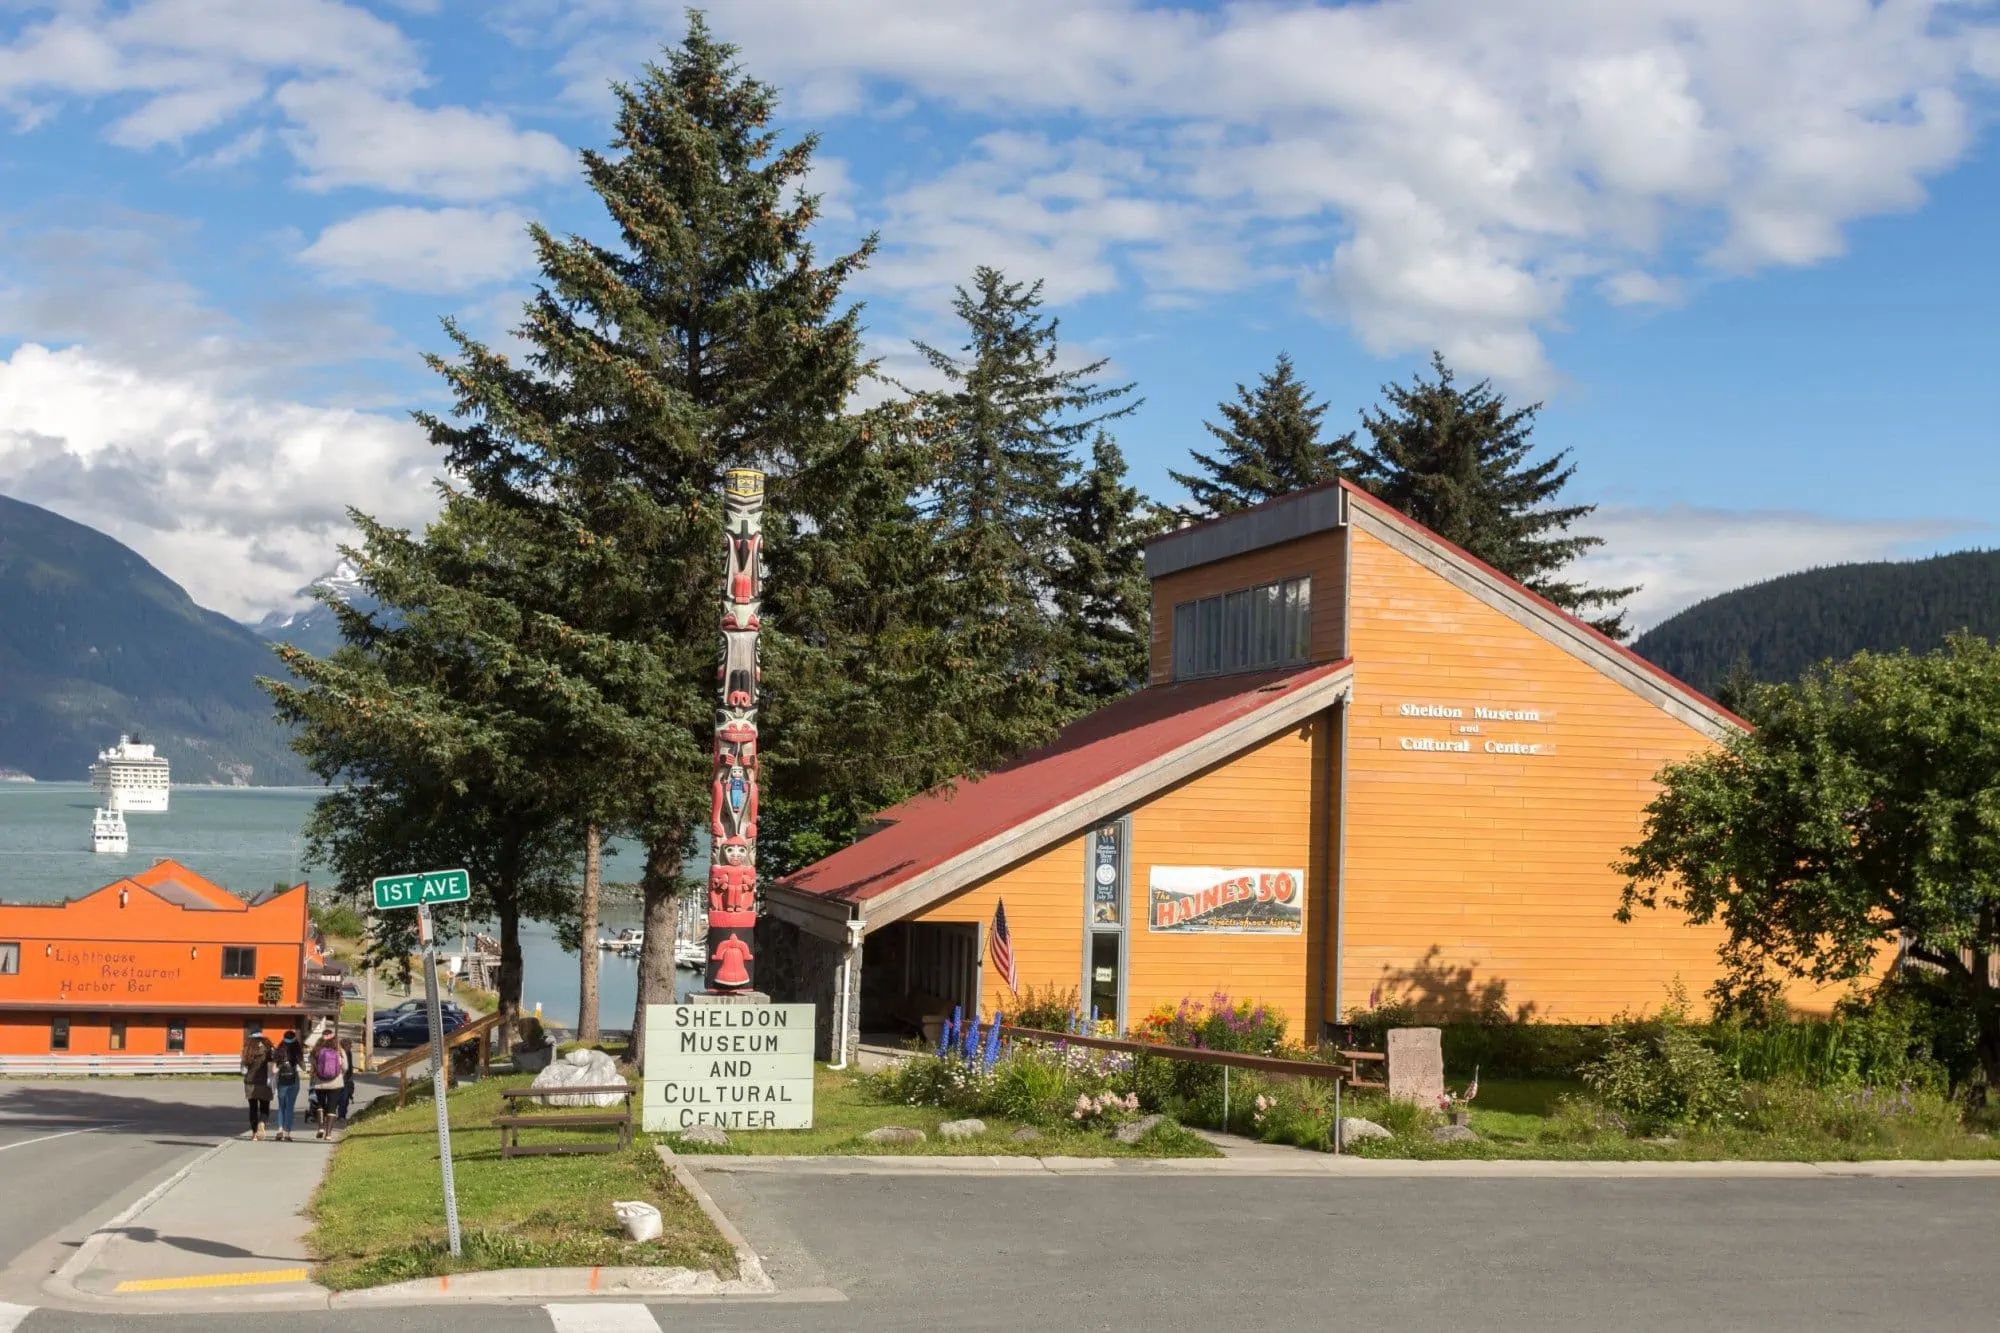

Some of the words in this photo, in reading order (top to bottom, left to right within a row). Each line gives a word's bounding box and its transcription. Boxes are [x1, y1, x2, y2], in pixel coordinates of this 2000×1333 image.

[1400, 703, 1462, 718] Sheldon
[1474, 706, 1539, 721] Museum
[1459, 725, 1479, 733] and
[1400, 736, 1470, 752] Cultural
[1484, 741, 1539, 755] Center
[382, 882, 414, 902] 1ST
[422, 877, 461, 898] AVE
[1154, 890, 1170, 900] The
[1156, 876, 1255, 928] HAINES
[1256, 871, 1297, 904] 50
[1207, 917, 1235, 929] objects
[1238, 917, 1249, 929] of
[1269, 917, 1297, 930] history
[55, 949, 137, 966] Lighthouse
[101, 964, 181, 978] Restaurant
[60, 979, 117, 993] Harbor
[127, 979, 153, 993] Bar
[674, 1006, 788, 1028] SHELDON
[680, 1031, 779, 1053] MUSEUM
[709, 1060, 752, 1078] AND
[664, 1082, 793, 1105] CULTURAL
[679, 1108, 776, 1129] CENTER
